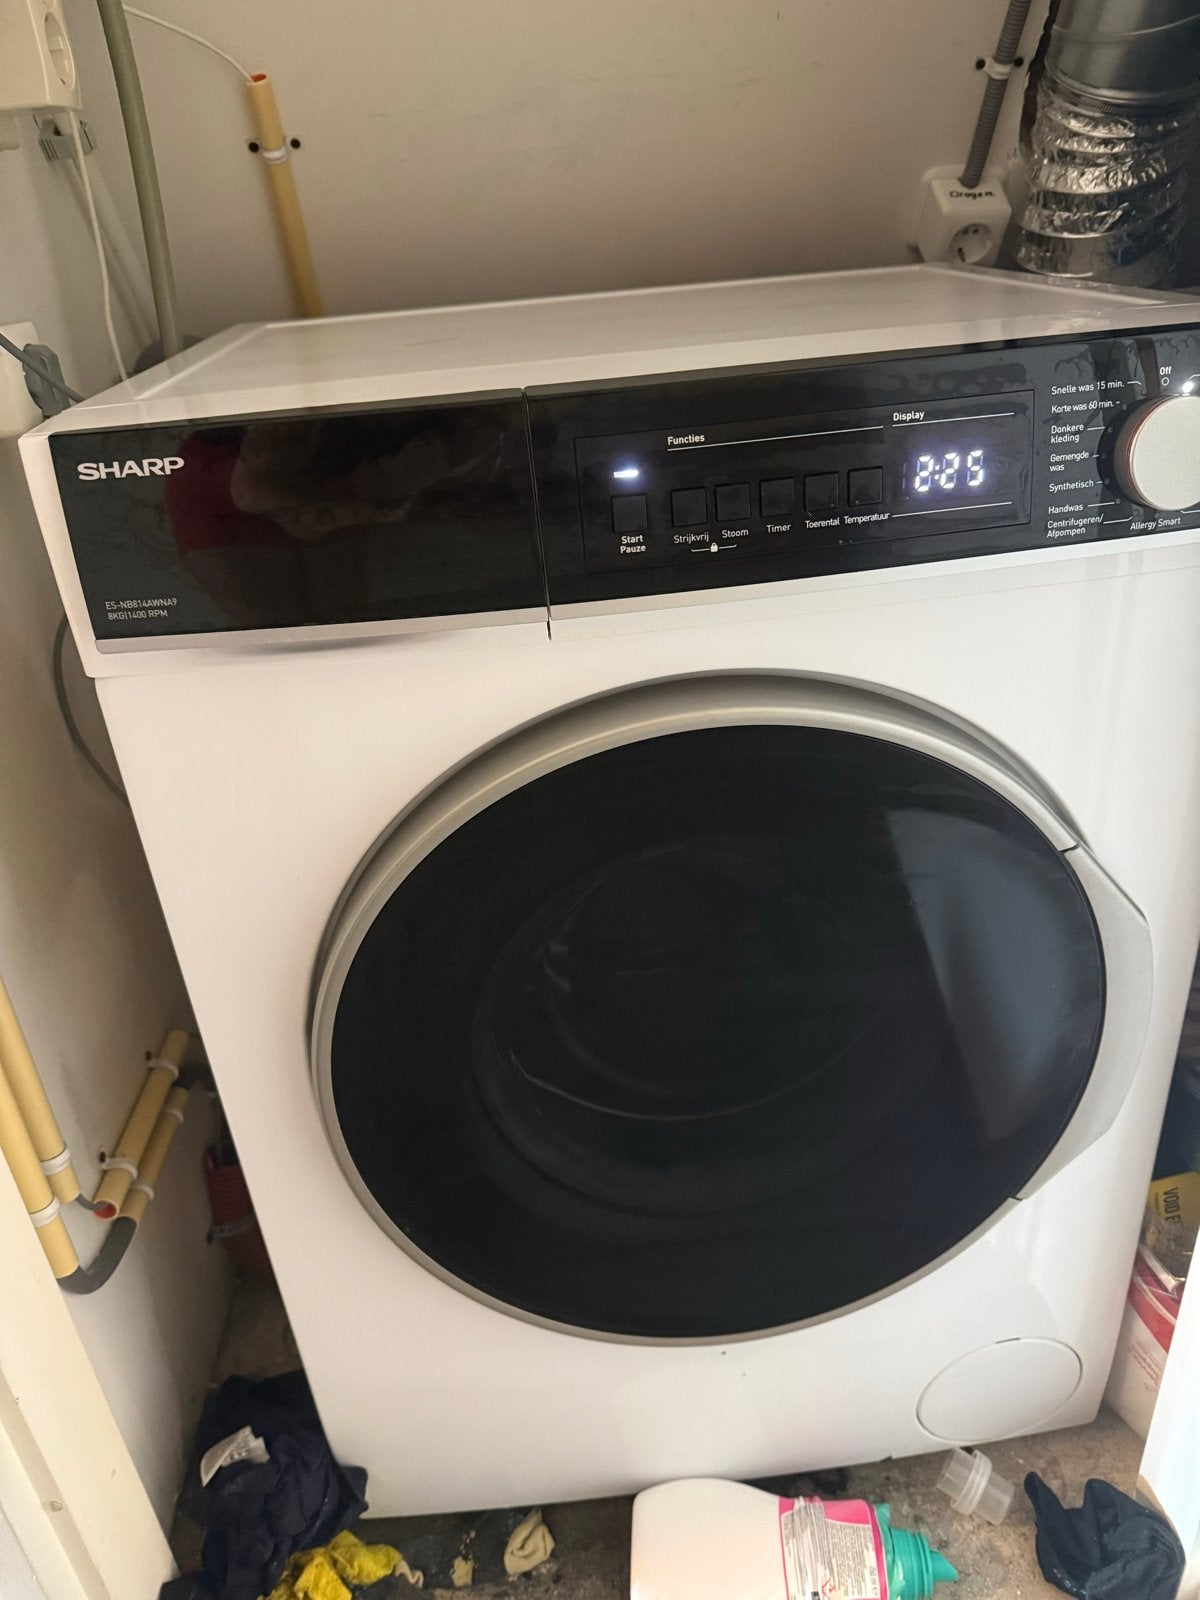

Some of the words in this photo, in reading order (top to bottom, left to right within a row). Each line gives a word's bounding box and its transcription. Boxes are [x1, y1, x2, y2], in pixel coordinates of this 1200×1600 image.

[1159, 366, 1172, 376] Off
[1051, 385, 1077, 395] Snelle
[1077, 384, 1095, 392] was
[1096, 381, 1106, 390] 15
[1107, 380, 1126, 389] min.
[1051, 404, 1072, 414] Korte
[1088, 401, 1098, 410] 60
[1098, 400, 1115, 409] min.
[892, 411, 925, 422] Display
[1051, 423, 1085, 434] Donkere
[667, 433, 706, 446] Functies
[1050, 433, 1080, 444] kleding
[1050, 451, 1090, 463] Gemengde
[77, 456, 185, 481] SHARP
[914, 449, 985, 492] 2:25
[1050, 464, 1065, 472] was
[1049, 479, 1095, 494] Synthetisch
[1048, 503, 1084, 515] Handwas
[804, 517, 840, 529] Toerental
[844, 512, 890, 525] Temperatuur
[1047, 514, 1104, 529] Centrifugeren/
[1130, 520, 1157, 531] Allergy
[1157, 517, 1181, 527] Smart
[721, 528, 749, 538] Stoom
[766, 523, 792, 534] Timer
[1046, 527, 1086, 539] Afpompen
[621, 534, 644, 545] Start
[673, 531, 710, 544] Strijkvrij
[620, 544, 646, 554] Pauze
[148, 609, 168, 618] RPM
